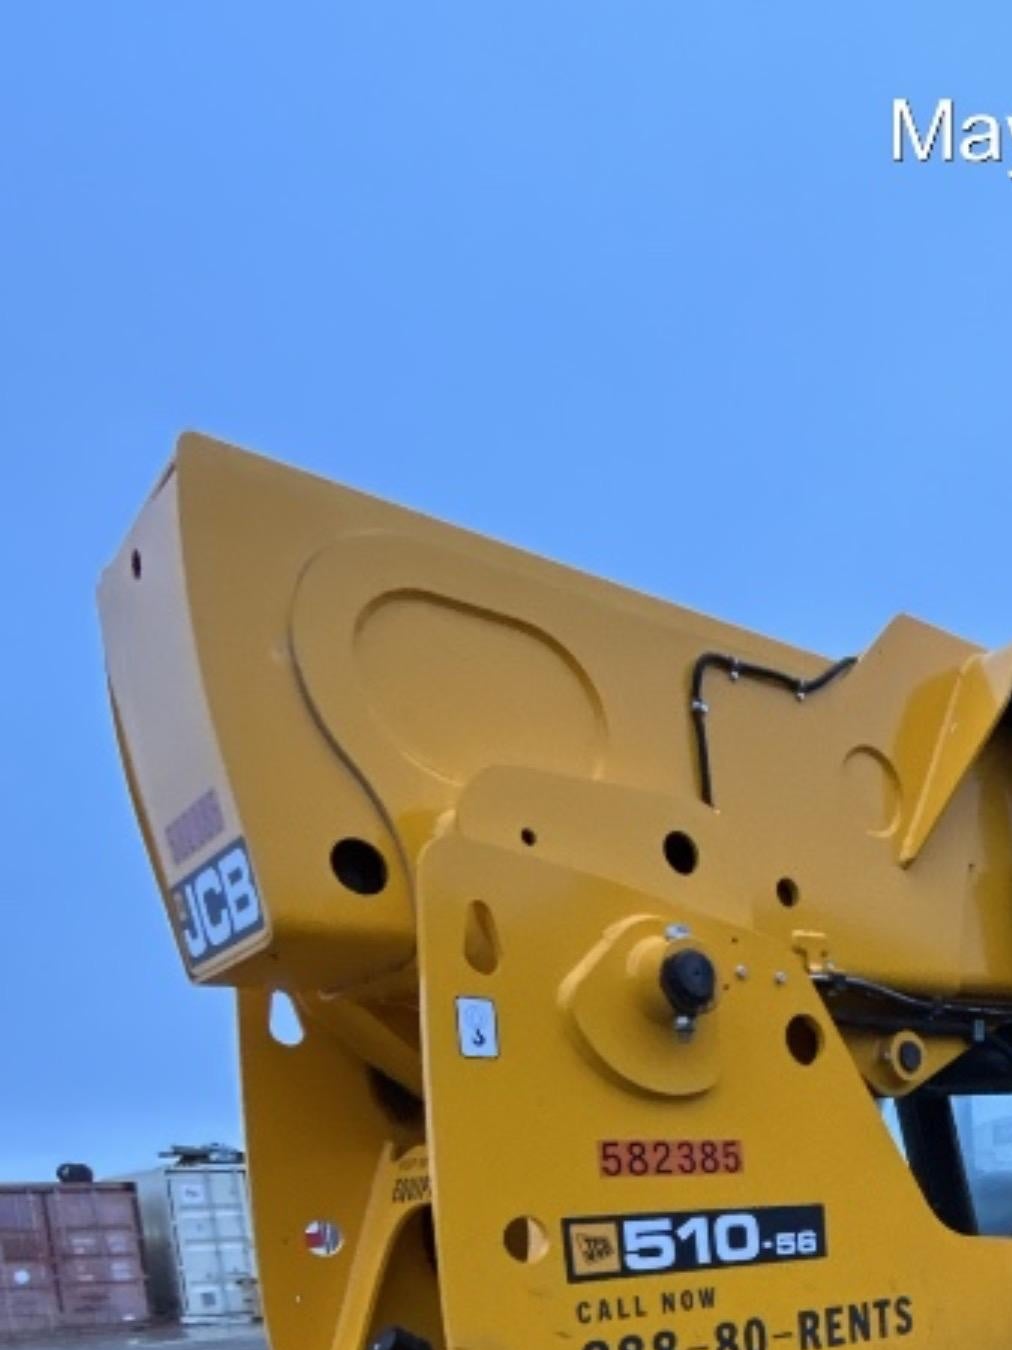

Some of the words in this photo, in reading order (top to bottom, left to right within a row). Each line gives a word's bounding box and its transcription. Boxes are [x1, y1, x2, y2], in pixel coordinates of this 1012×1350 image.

[174, 846, 263, 960] JCB
[600, 1140, 742, 1177] 582385
[576, 1295, 648, 1324] CALL
[661, 1287, 716, 1315] NOW
